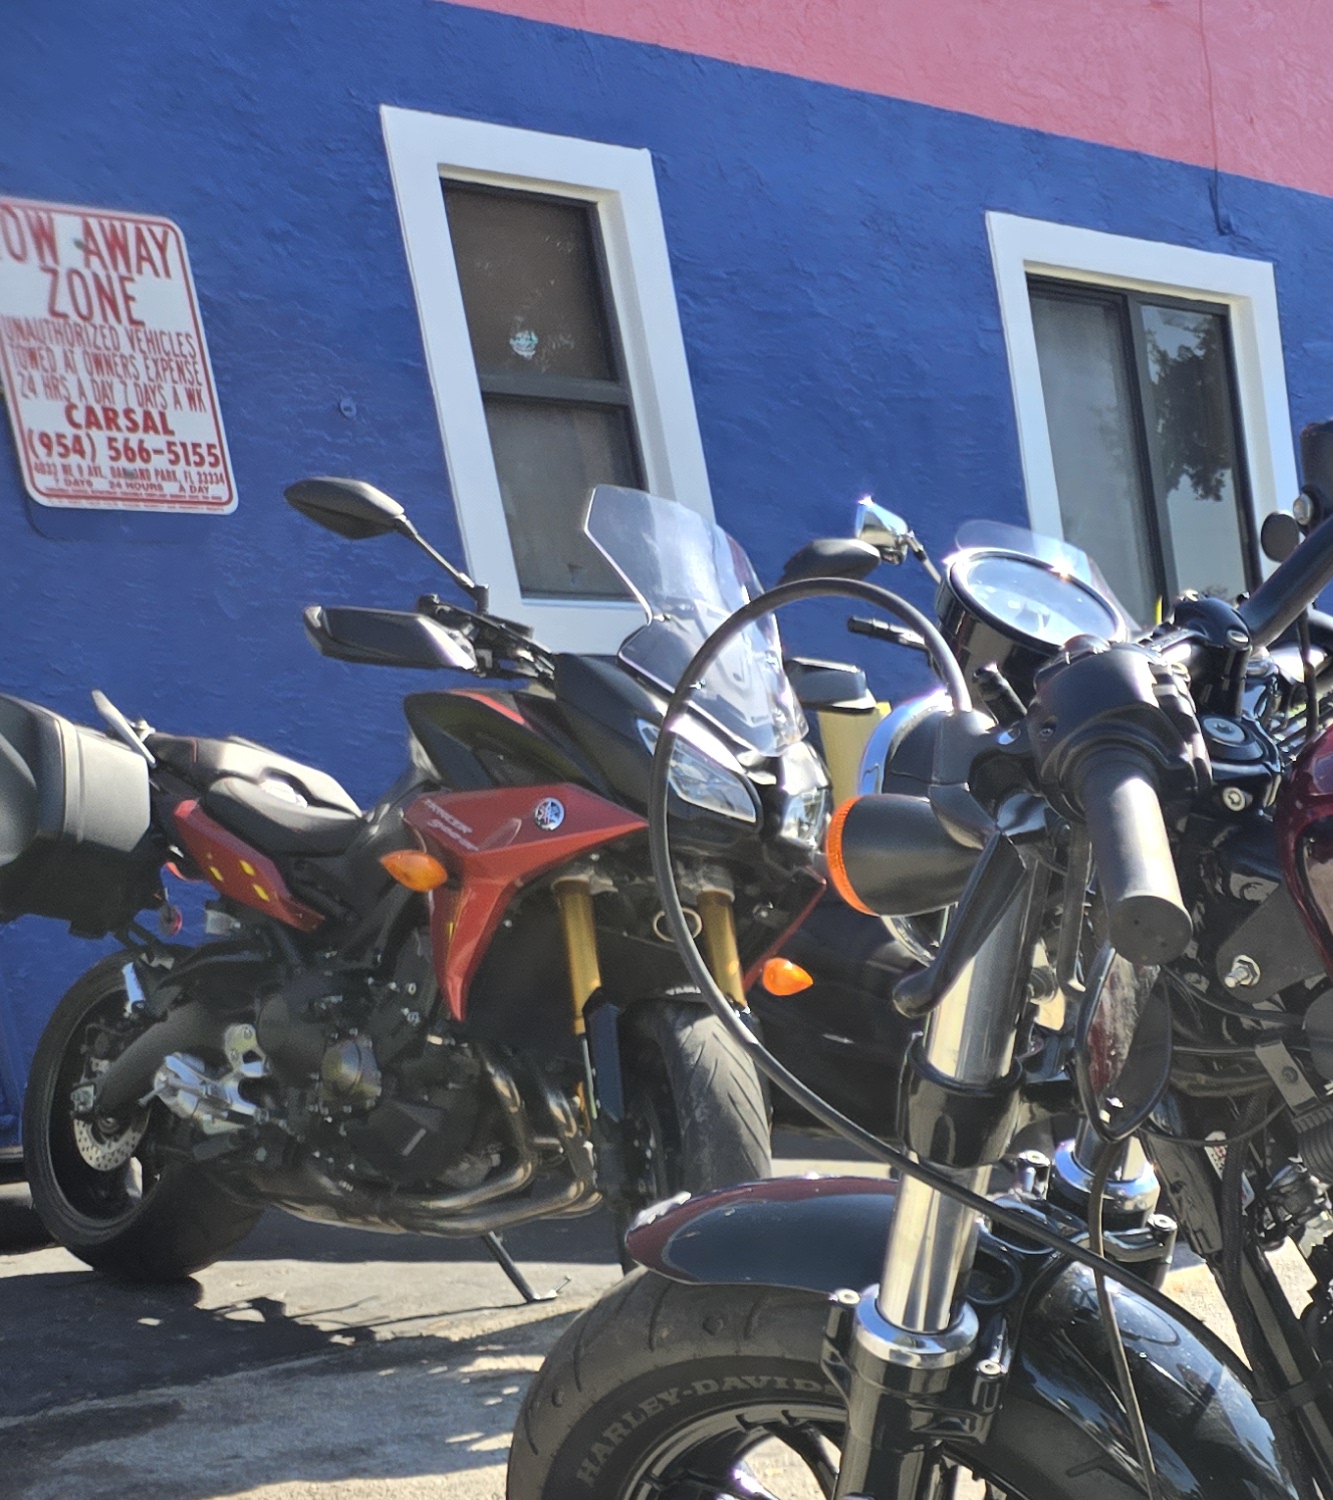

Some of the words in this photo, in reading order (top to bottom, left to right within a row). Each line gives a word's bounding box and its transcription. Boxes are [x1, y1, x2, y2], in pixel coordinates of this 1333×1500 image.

[0, 203, 59, 267] OW
[81, 214, 172, 280] AWAY
[40, 267, 146, 328] ZONE
[3, 316, 120, 352] UNAUTHORIZED
[125, 325, 197, 360] VEHICLES
[63, 348, 78, 375] AT
[82, 350, 141, 381] OWNERS
[143, 355, 204, 388] EXPENSE
[17, 370, 38, 401] 24
[42, 374, 72, 402] HRS
[77, 376, 88, 404] A
[90, 377, 117, 407] DAY
[119, 380, 131, 409] 7
[133, 382, 168, 411] DAYS
[172, 386, 183, 412] A
[185, 387, 207, 414] WK
[65, 402, 176, 437] CARSAL
[27, 427, 96, 465] (954)
[107, 436, 221, 469] 566-5155
[576, 1375, 844, 1488] HARLEY-DAVIDS
